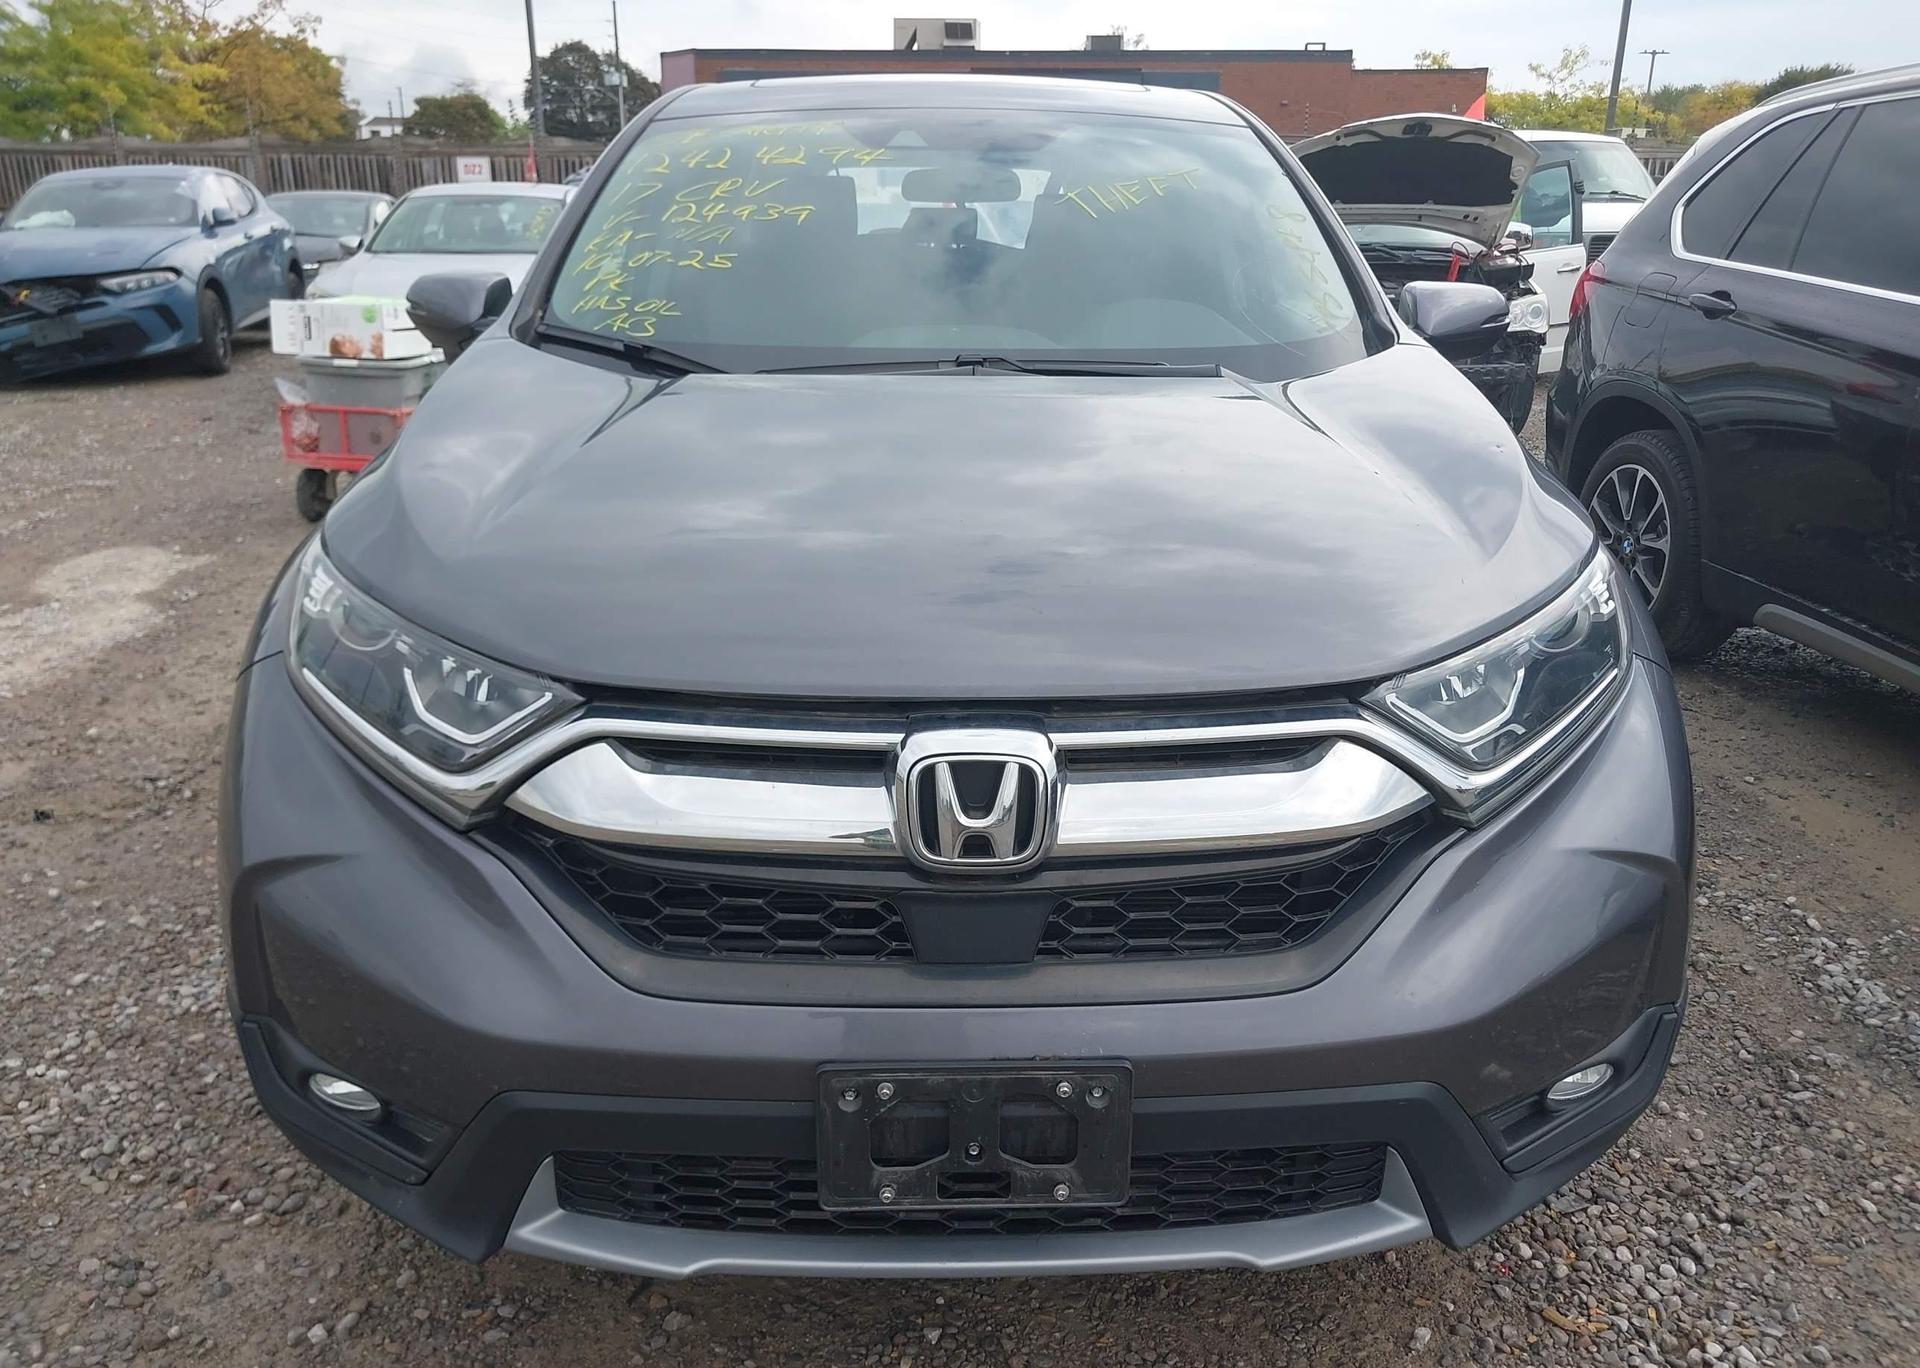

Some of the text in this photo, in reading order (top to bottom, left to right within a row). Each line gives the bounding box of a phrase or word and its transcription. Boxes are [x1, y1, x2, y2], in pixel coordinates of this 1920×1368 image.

[608, 177, 788, 207] 17 CRV
[1053, 167, 1201, 219] THEFT
[660, 202, 817, 226] 124939
[571, 295, 683, 316] HAS OIL
